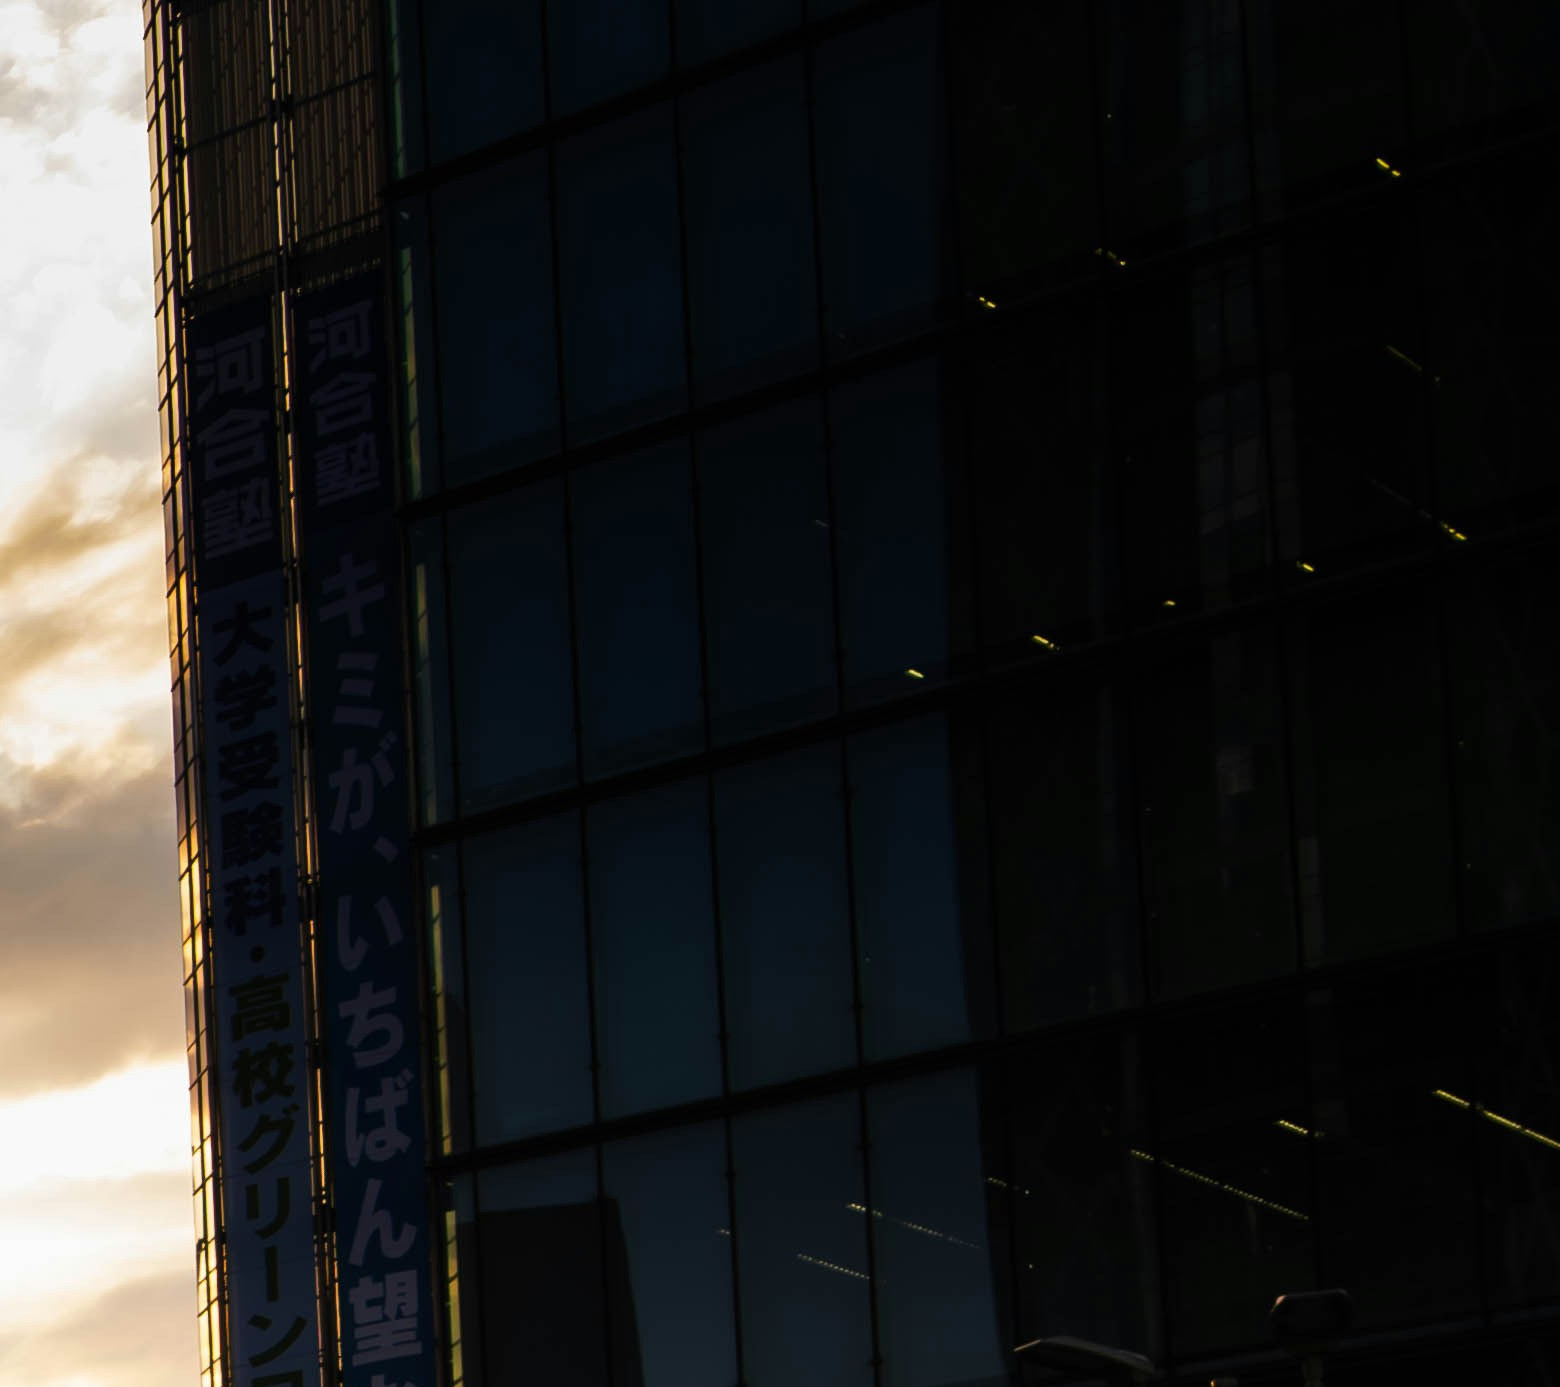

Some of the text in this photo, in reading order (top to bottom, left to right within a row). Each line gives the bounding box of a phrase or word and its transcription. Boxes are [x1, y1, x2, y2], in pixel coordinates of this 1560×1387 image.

[196, 326, 274, 561] 河合塾
[307, 296, 383, 509] 河合塾
